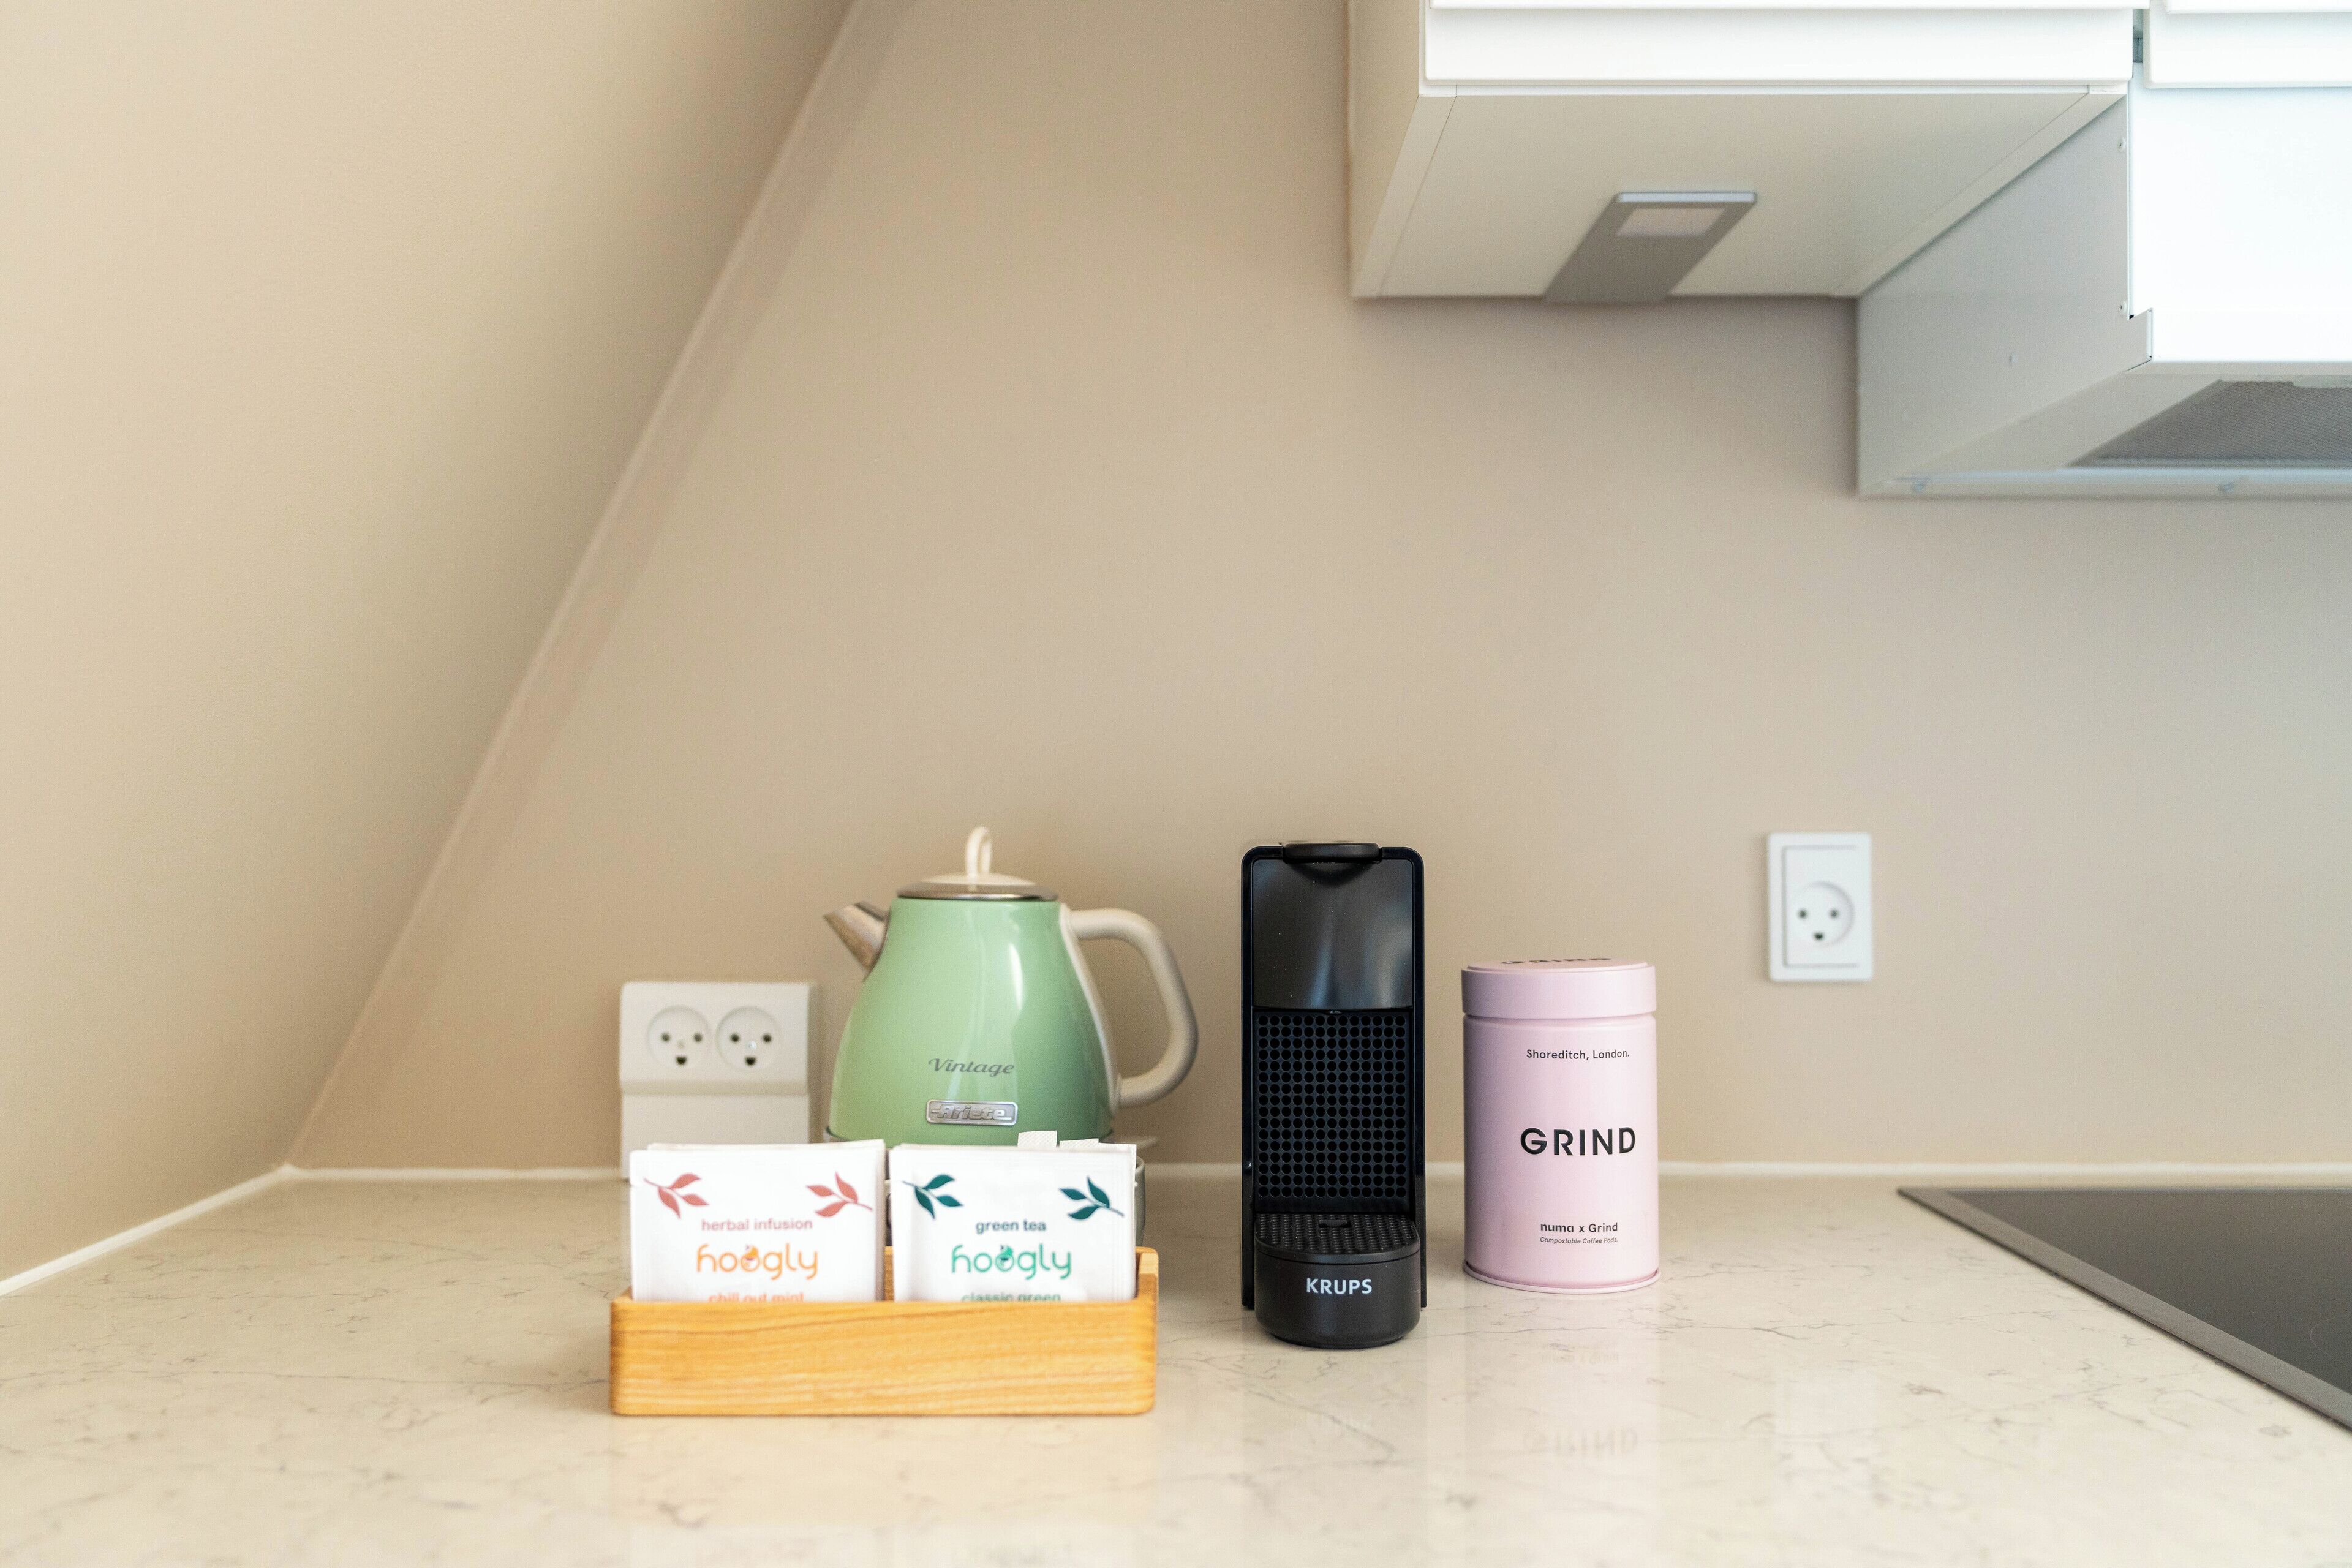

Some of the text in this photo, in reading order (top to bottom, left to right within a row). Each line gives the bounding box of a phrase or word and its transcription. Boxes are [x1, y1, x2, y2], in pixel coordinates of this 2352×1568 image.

[1526, 1049, 1630, 1061] Shoreditch, London.
[928, 1058, 1015, 1077] Vintage
[931, 1104, 1012, 1121] Ariete
[1520, 1127, 1635, 1156] GRIND
[701, 1218, 813, 1231] herbal infusion
[975, 1219, 1047, 1235] green tea
[1540, 1223, 1575, 1232] numa
[1588, 1222, 1618, 1232] Grind
[696, 1243, 818, 1280] hoogly
[952, 1243, 1072, 1280] hoogly
[1306, 1277, 1373, 1295] KRUPS
